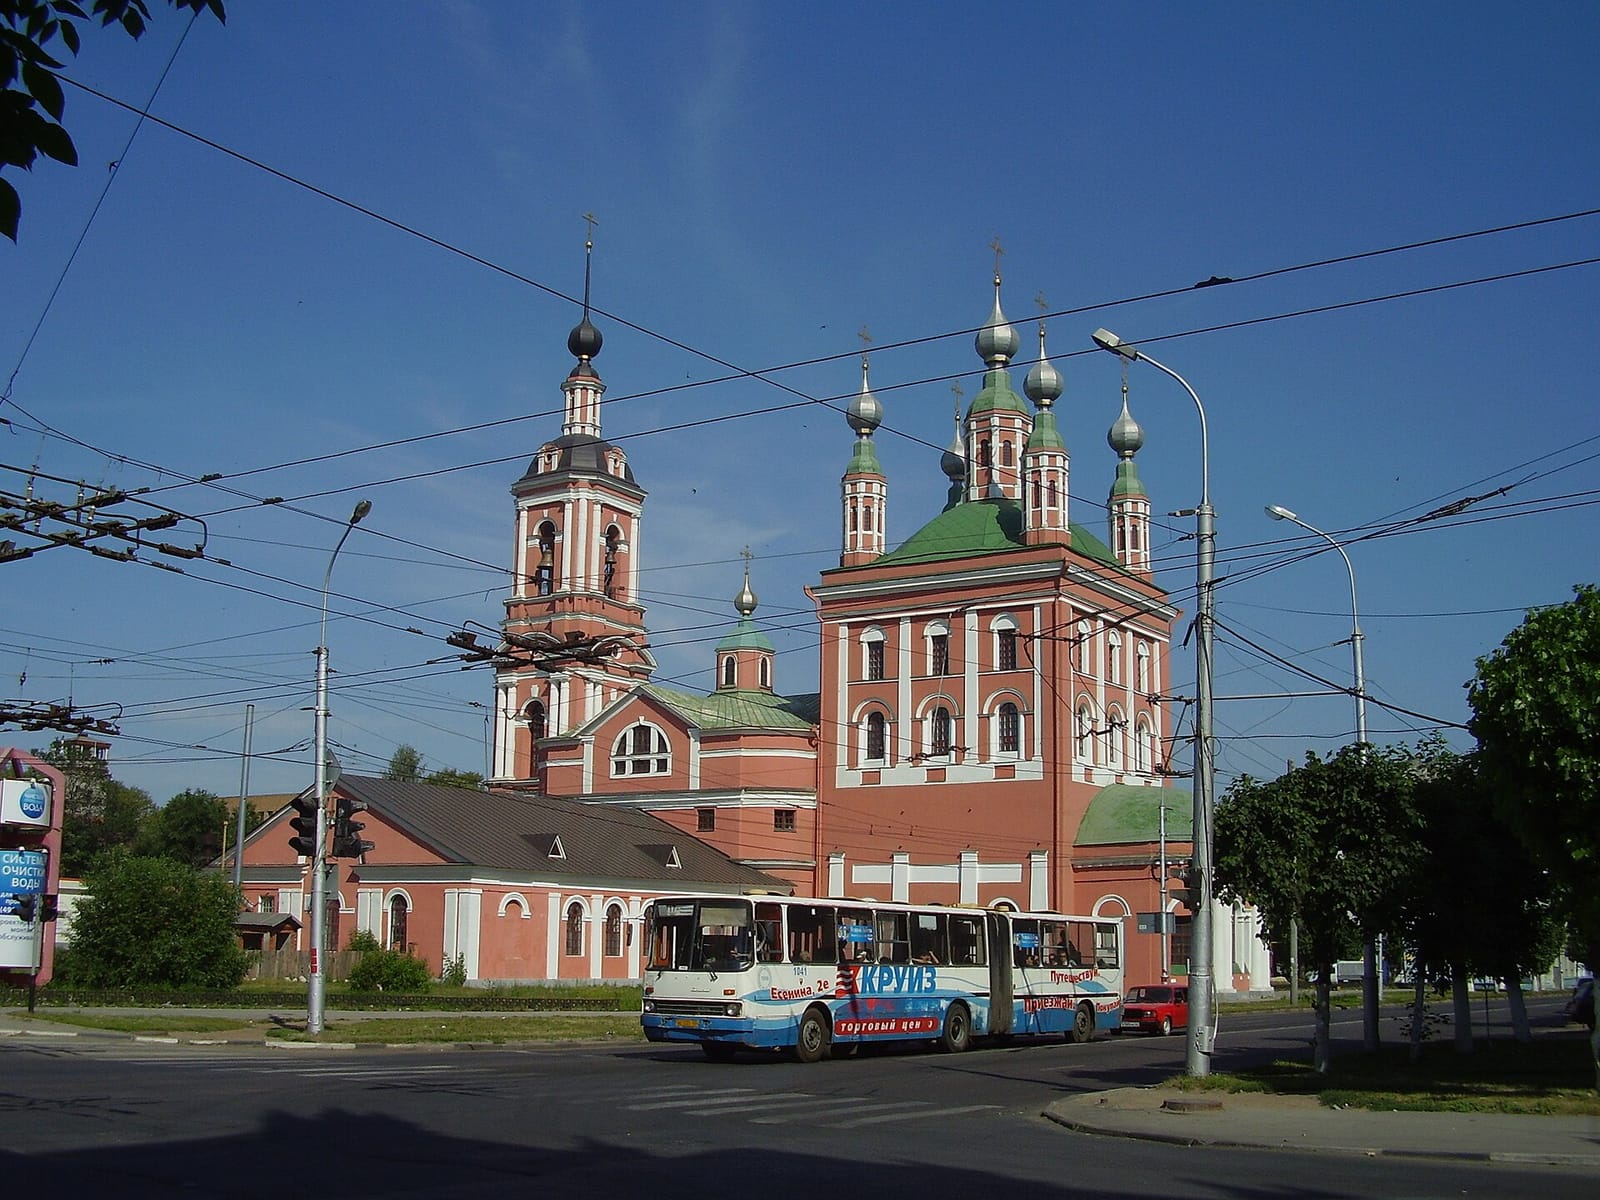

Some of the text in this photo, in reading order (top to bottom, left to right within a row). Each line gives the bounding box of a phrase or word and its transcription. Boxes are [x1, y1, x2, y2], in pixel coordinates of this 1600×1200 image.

[11, 877, 41, 890] ВОДЫ
[793, 967, 808, 977] 1041
[861, 966, 937, 994] КРУИЗ
[771, 980, 829, 1000] Есенина, 2е
[840, 1019, 933, 1033] торговый цен
